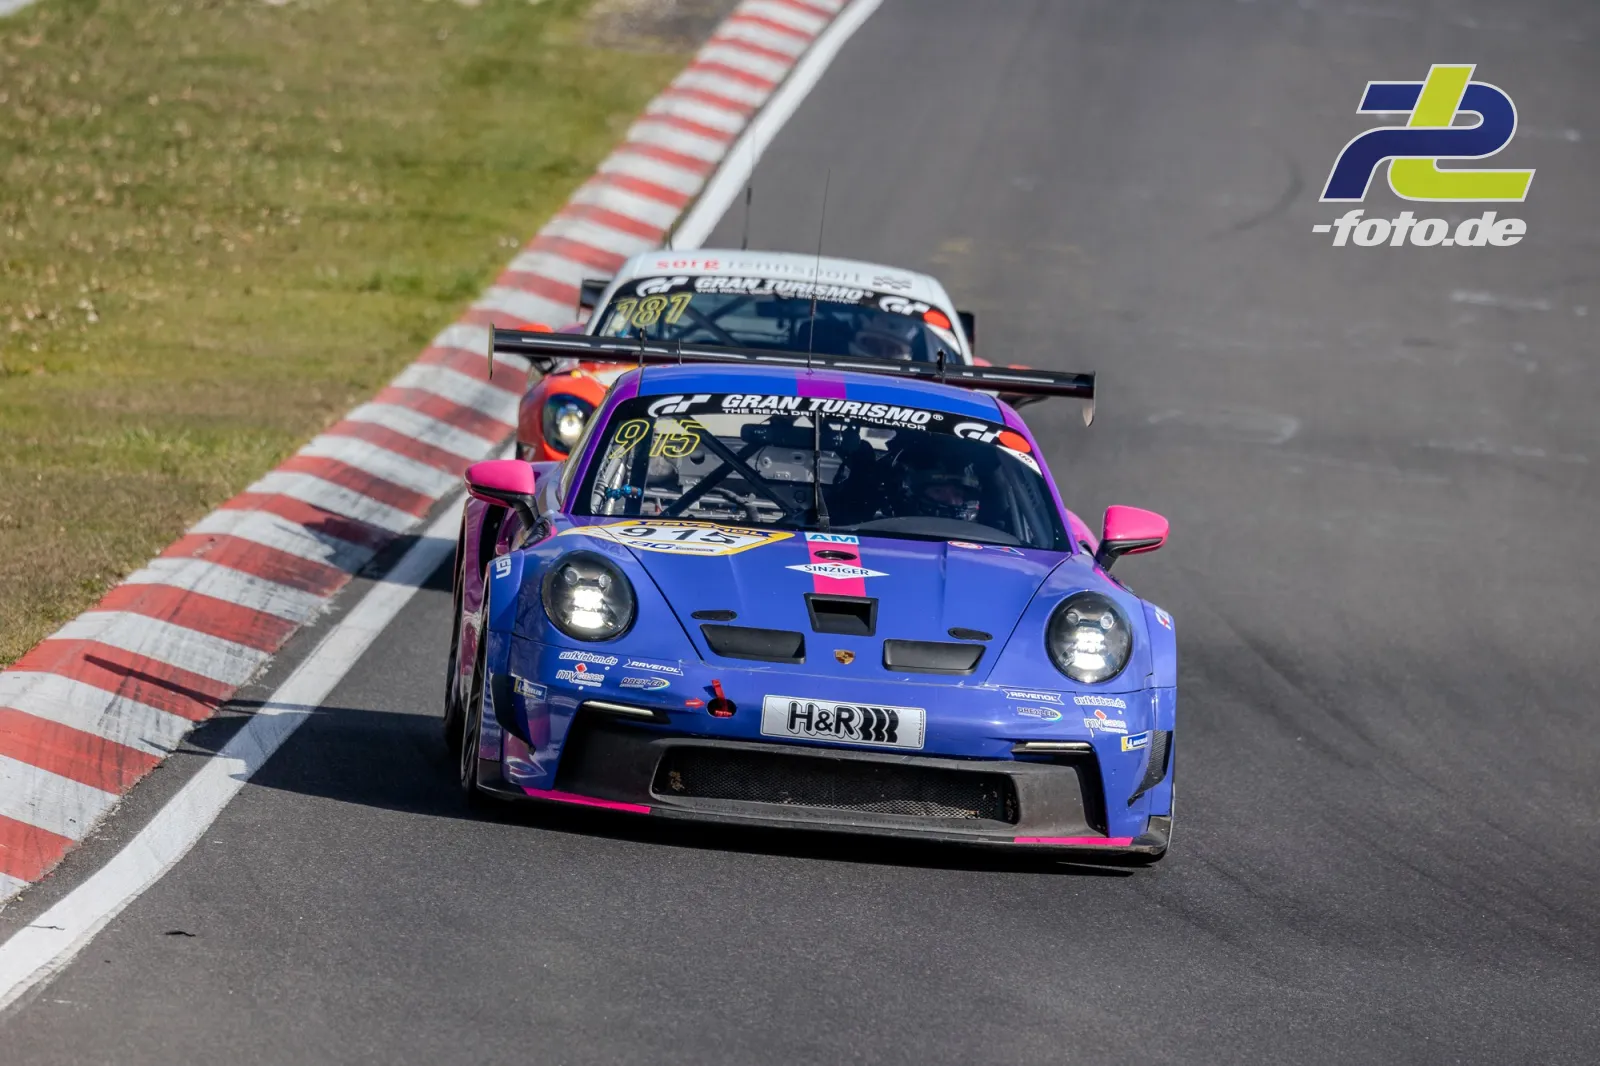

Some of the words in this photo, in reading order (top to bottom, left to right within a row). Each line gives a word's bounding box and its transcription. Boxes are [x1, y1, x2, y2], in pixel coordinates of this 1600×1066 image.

[656, 260, 720, 271] sorg
[694, 276, 762, 290] GRAN
[615, 292, 693, 328] 181
[721, 394, 802, 410] GRAN
[755, 408, 788, 416] REAL
[609, 419, 710, 459] 915
[618, 527, 741, 545] 915
[810, 534, 857, 543] AM
[804, 565, 869, 576] SINZIGER
[559, 651, 618, 666] aufkleben.de
[631, 660, 681, 673] RAVENOL
[1010, 692, 1058, 702] RAVENOL
[789, 701, 857, 736] H&R
